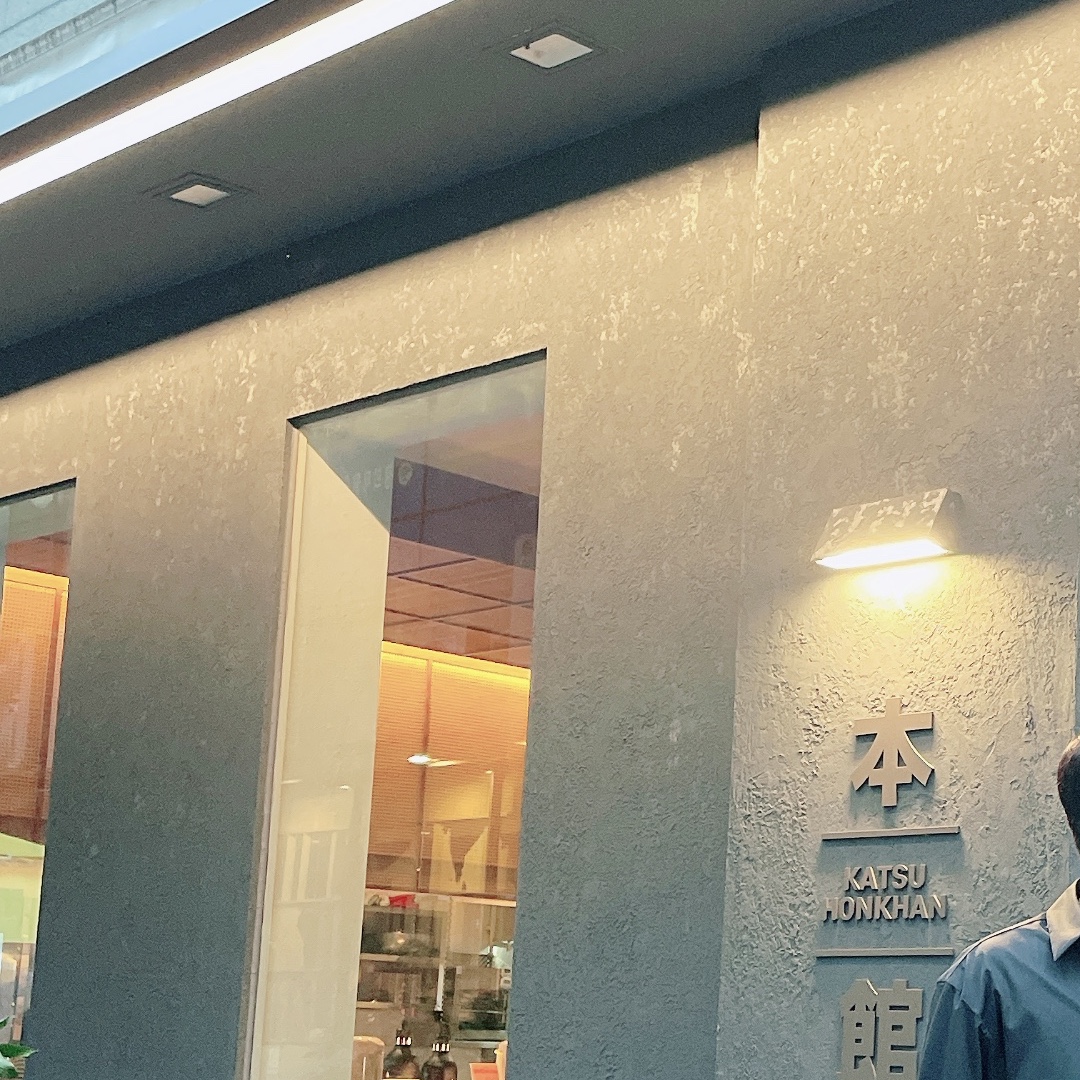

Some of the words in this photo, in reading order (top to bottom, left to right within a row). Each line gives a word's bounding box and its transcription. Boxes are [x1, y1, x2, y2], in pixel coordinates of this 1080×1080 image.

[850, 697, 935, 807] 本
[844, 863, 928, 892] KATSU
[823, 894, 948, 922] HONKHAN
